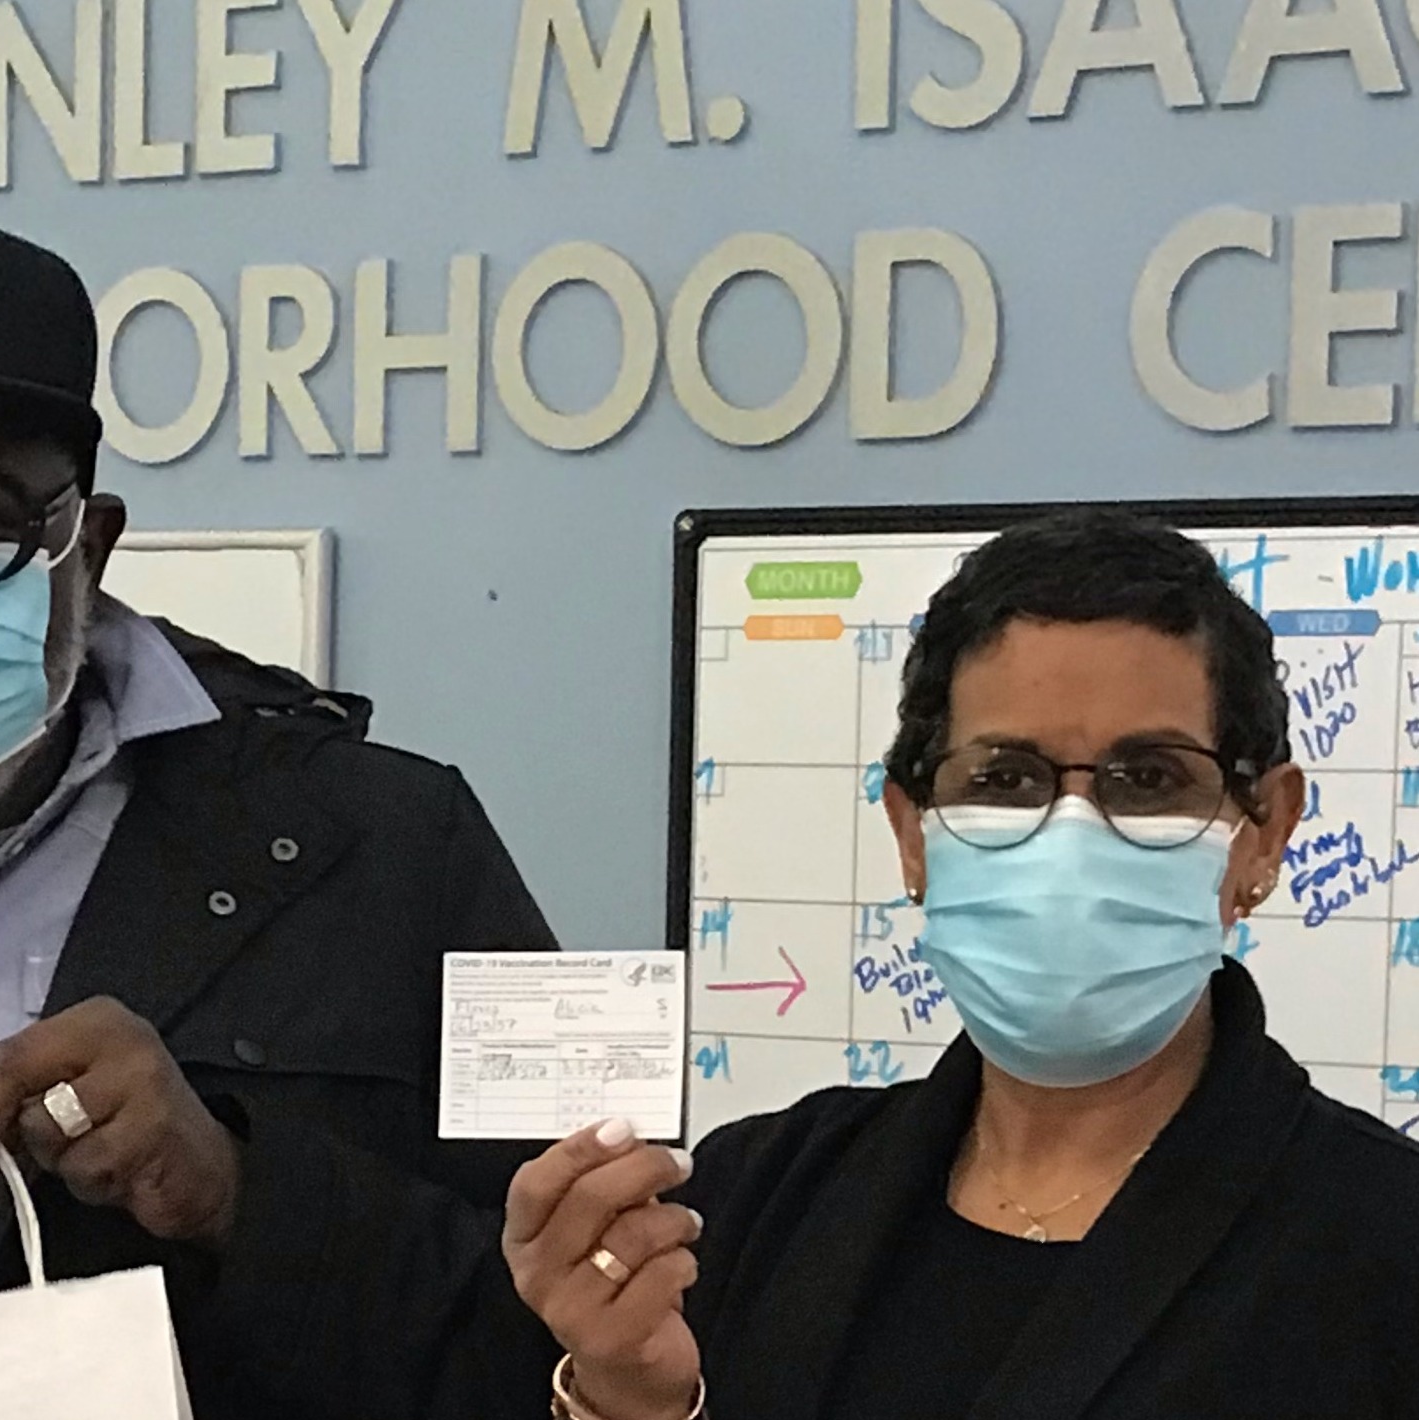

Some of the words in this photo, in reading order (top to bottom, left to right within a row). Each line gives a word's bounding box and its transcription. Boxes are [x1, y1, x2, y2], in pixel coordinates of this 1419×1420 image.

[505, 0, 747, 157] M.
[853, 0, 1419, 130] ISAA
[1129, 201, 1419, 432] CE
[755, 569, 850, 592] MONTH
[1297, 613, 1352, 633] WED
[499, 958, 554, 968] Vaccination
[555, 958, 588, 968] Record
[589, 957, 613, 968] Card
[844, 1040, 905, 1083] 22
